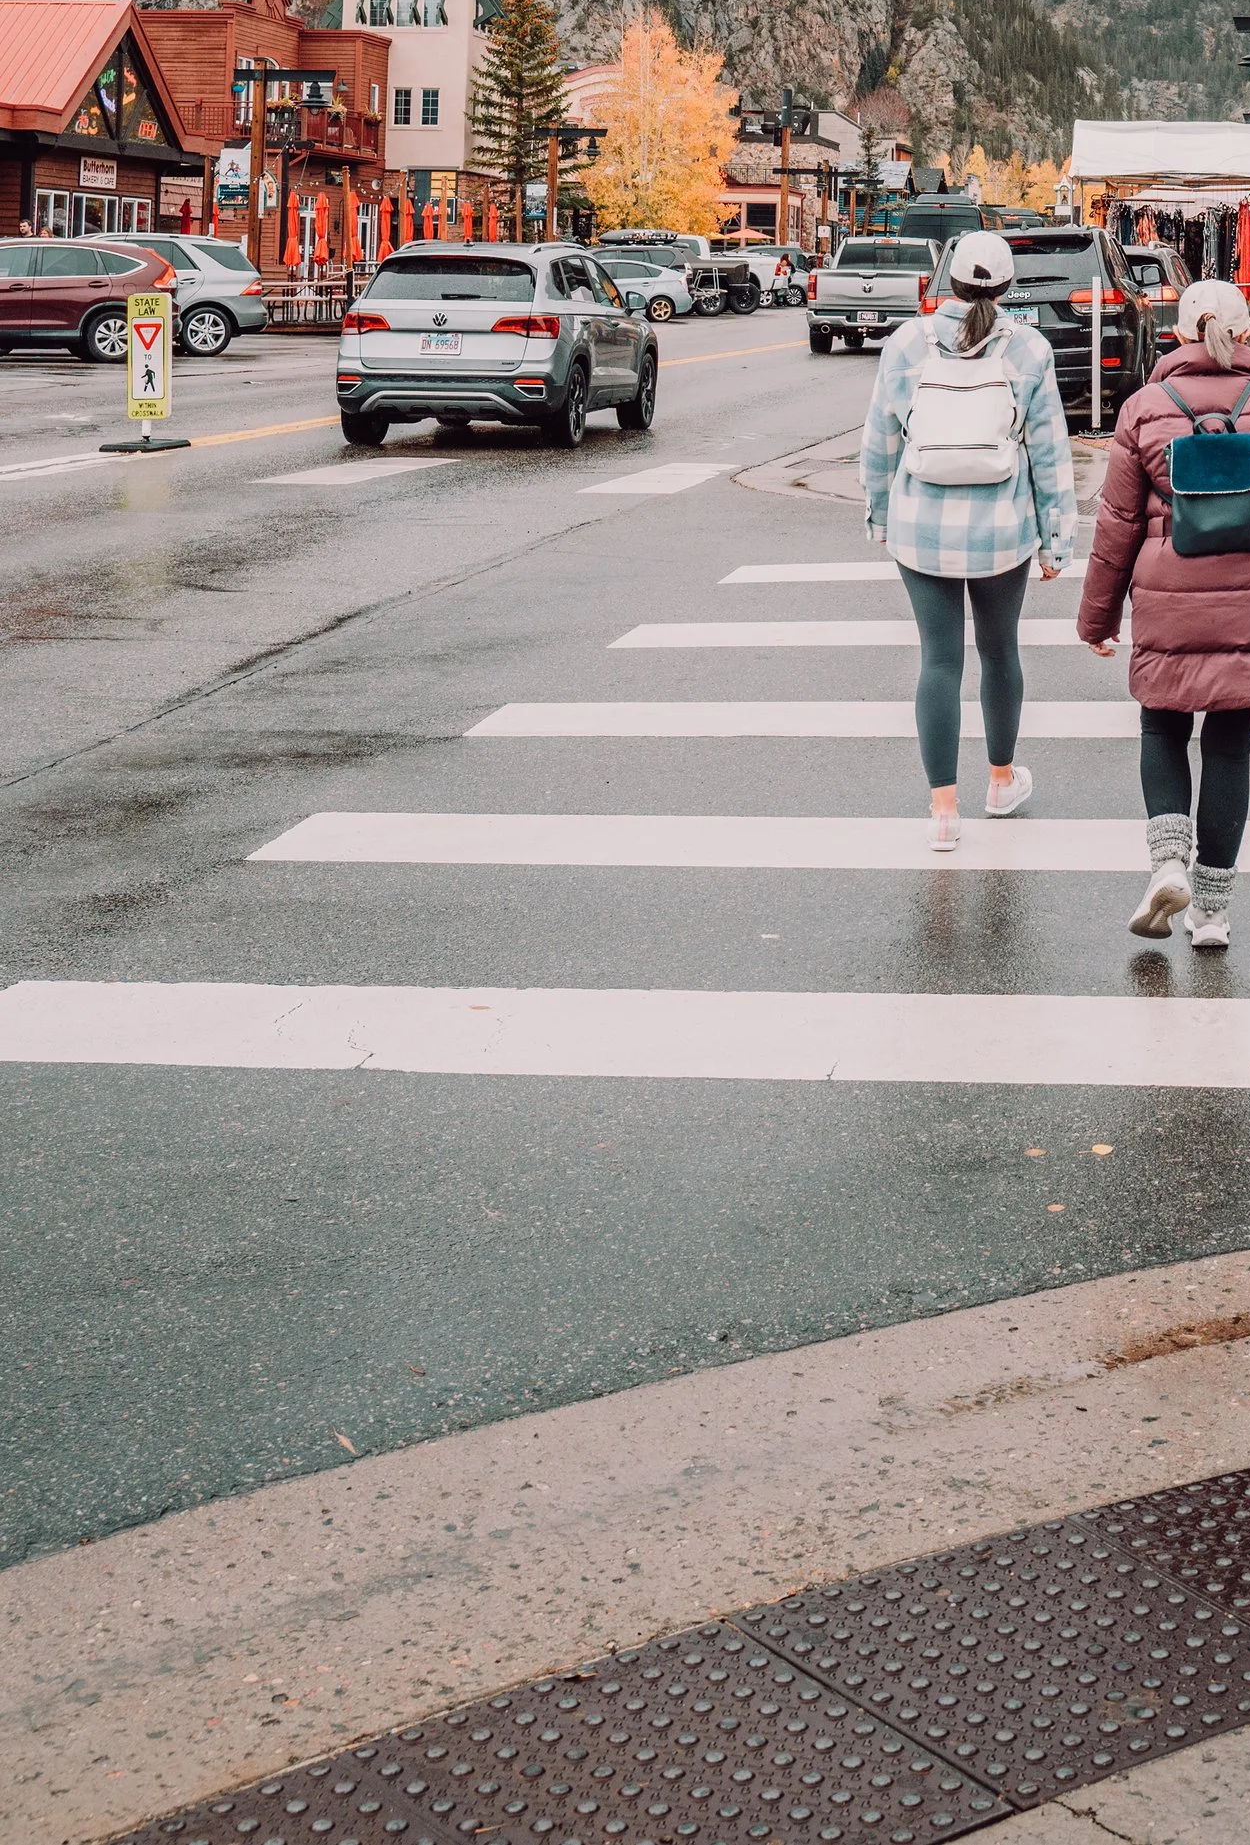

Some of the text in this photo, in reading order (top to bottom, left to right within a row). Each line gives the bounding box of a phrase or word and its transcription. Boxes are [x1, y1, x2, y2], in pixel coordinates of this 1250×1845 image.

[83, 159, 115, 175] Butterhorn
[1007, 290, 1031, 299] Jeep
[135, 298, 160, 307] STATE
[138, 307, 156, 316] LAW
[421, 339, 458, 350] DN 69568
